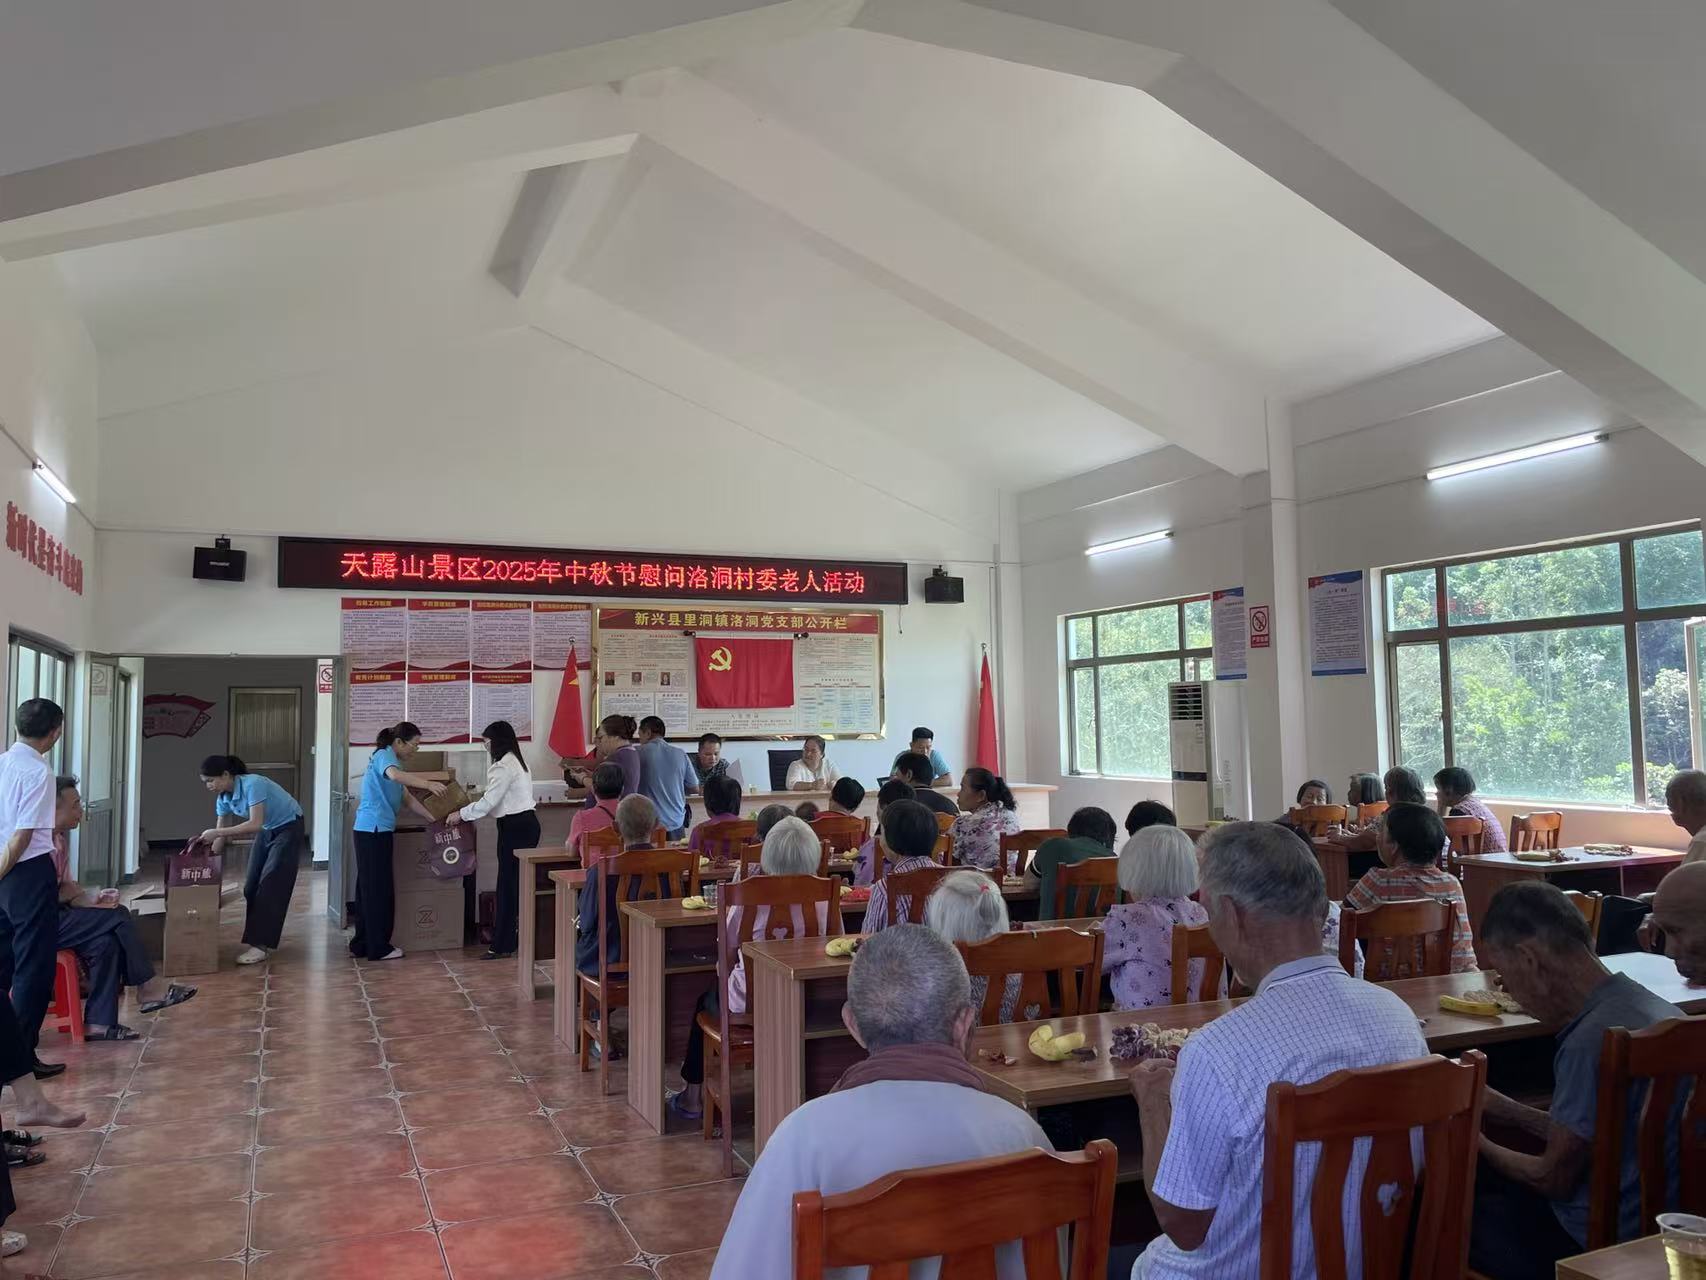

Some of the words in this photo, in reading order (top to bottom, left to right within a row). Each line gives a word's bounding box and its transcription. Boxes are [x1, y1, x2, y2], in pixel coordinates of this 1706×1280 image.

[340, 551, 866, 595] 天露山景区2025年中秋节慰问洛洞村委老人活动
[633, 610, 847, 631] 新兴县里洞镇洛洞党支部公开栏
